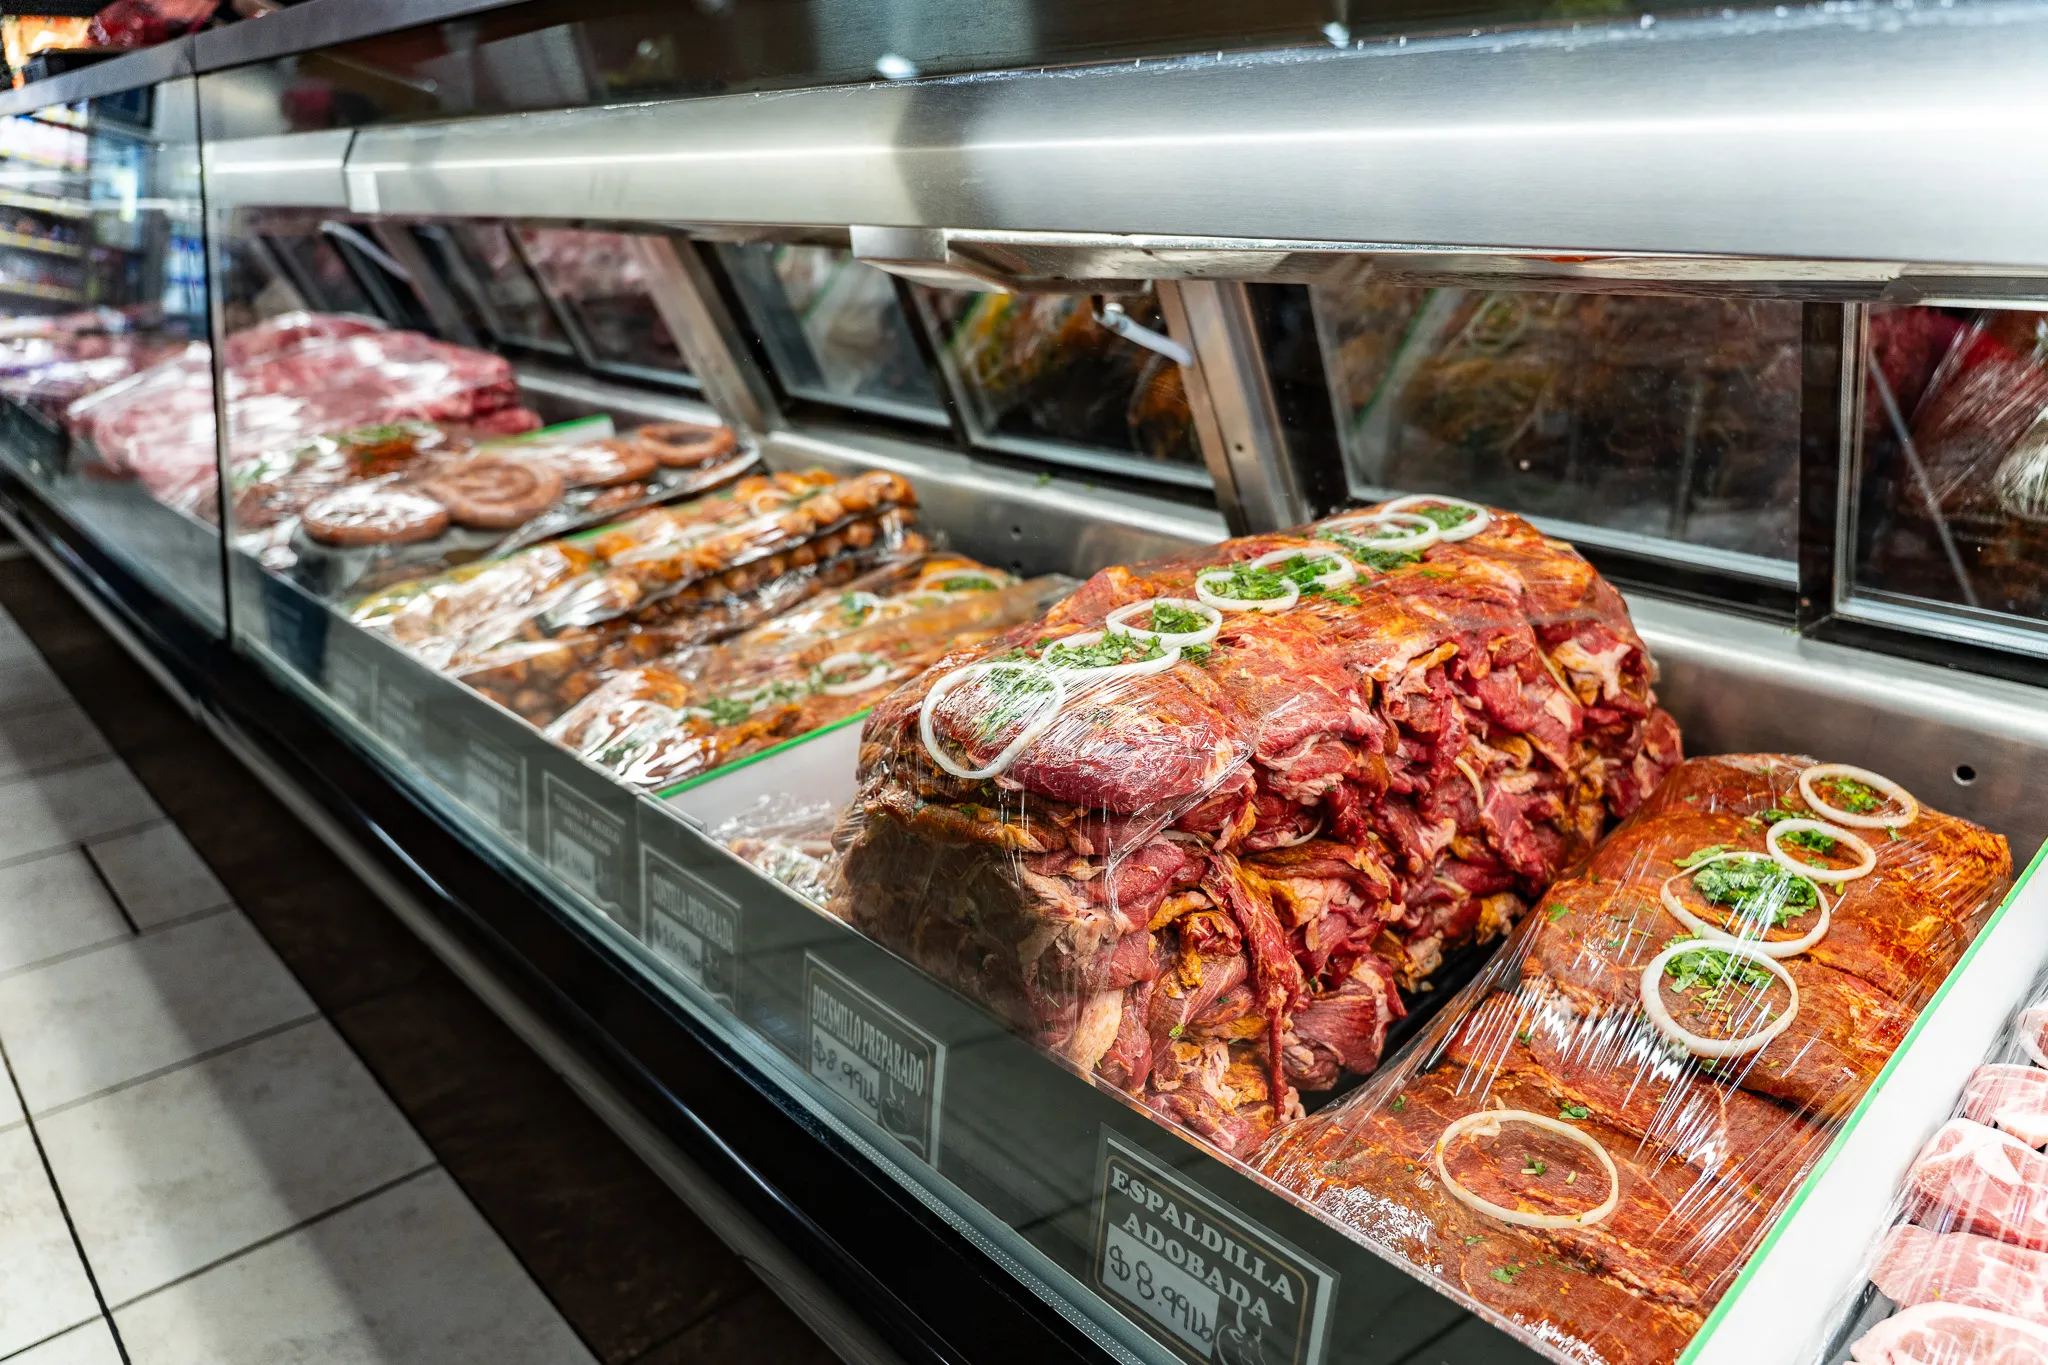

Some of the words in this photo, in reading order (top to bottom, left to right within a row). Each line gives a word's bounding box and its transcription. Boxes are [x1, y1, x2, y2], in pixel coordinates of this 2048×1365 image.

[812, 983, 862, 1052] DIESMILLO
[862, 1019, 925, 1097] PREPARADO
[1111, 1166, 1296, 1305] ESPALDILLA
[1121, 1212, 1273, 1327] ADOBADA
